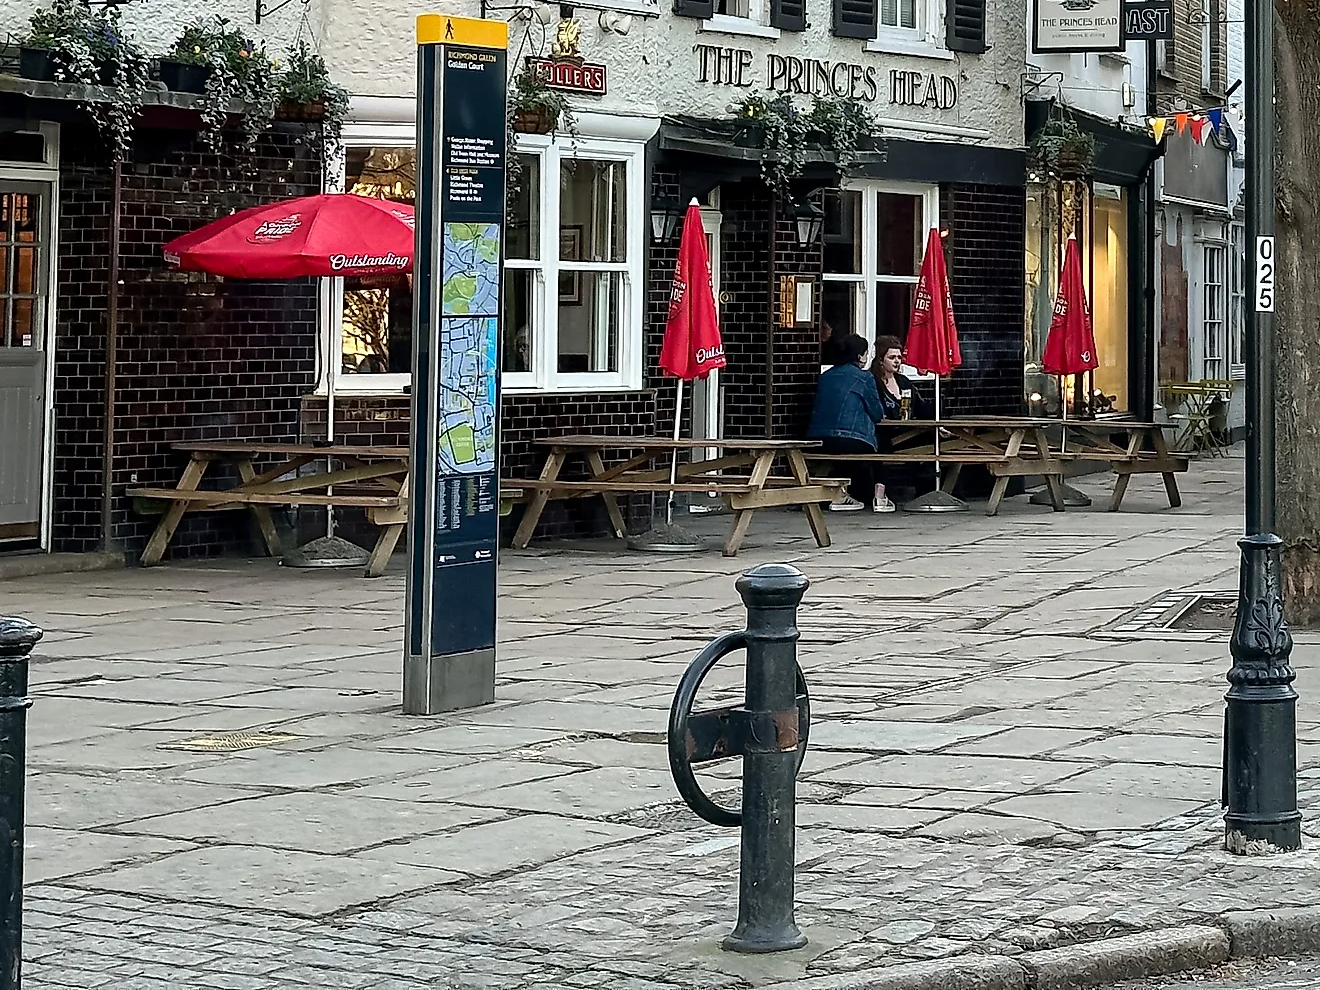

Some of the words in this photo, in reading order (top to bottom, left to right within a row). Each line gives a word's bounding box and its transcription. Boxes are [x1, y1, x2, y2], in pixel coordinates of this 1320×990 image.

[1041, 18, 1057, 28] THE
[1059, 17, 1093, 27] PRINCES
[1094, 17, 1118, 27] HEAD
[1125, 7, 1170, 34] AST
[692, 42, 754, 88] THE
[766, 54, 877, 102] PRINCES
[888, 68, 958, 110] HEAD
[330, 252, 409, 270] Outstanding
[1259, 239, 1273, 309] 025
